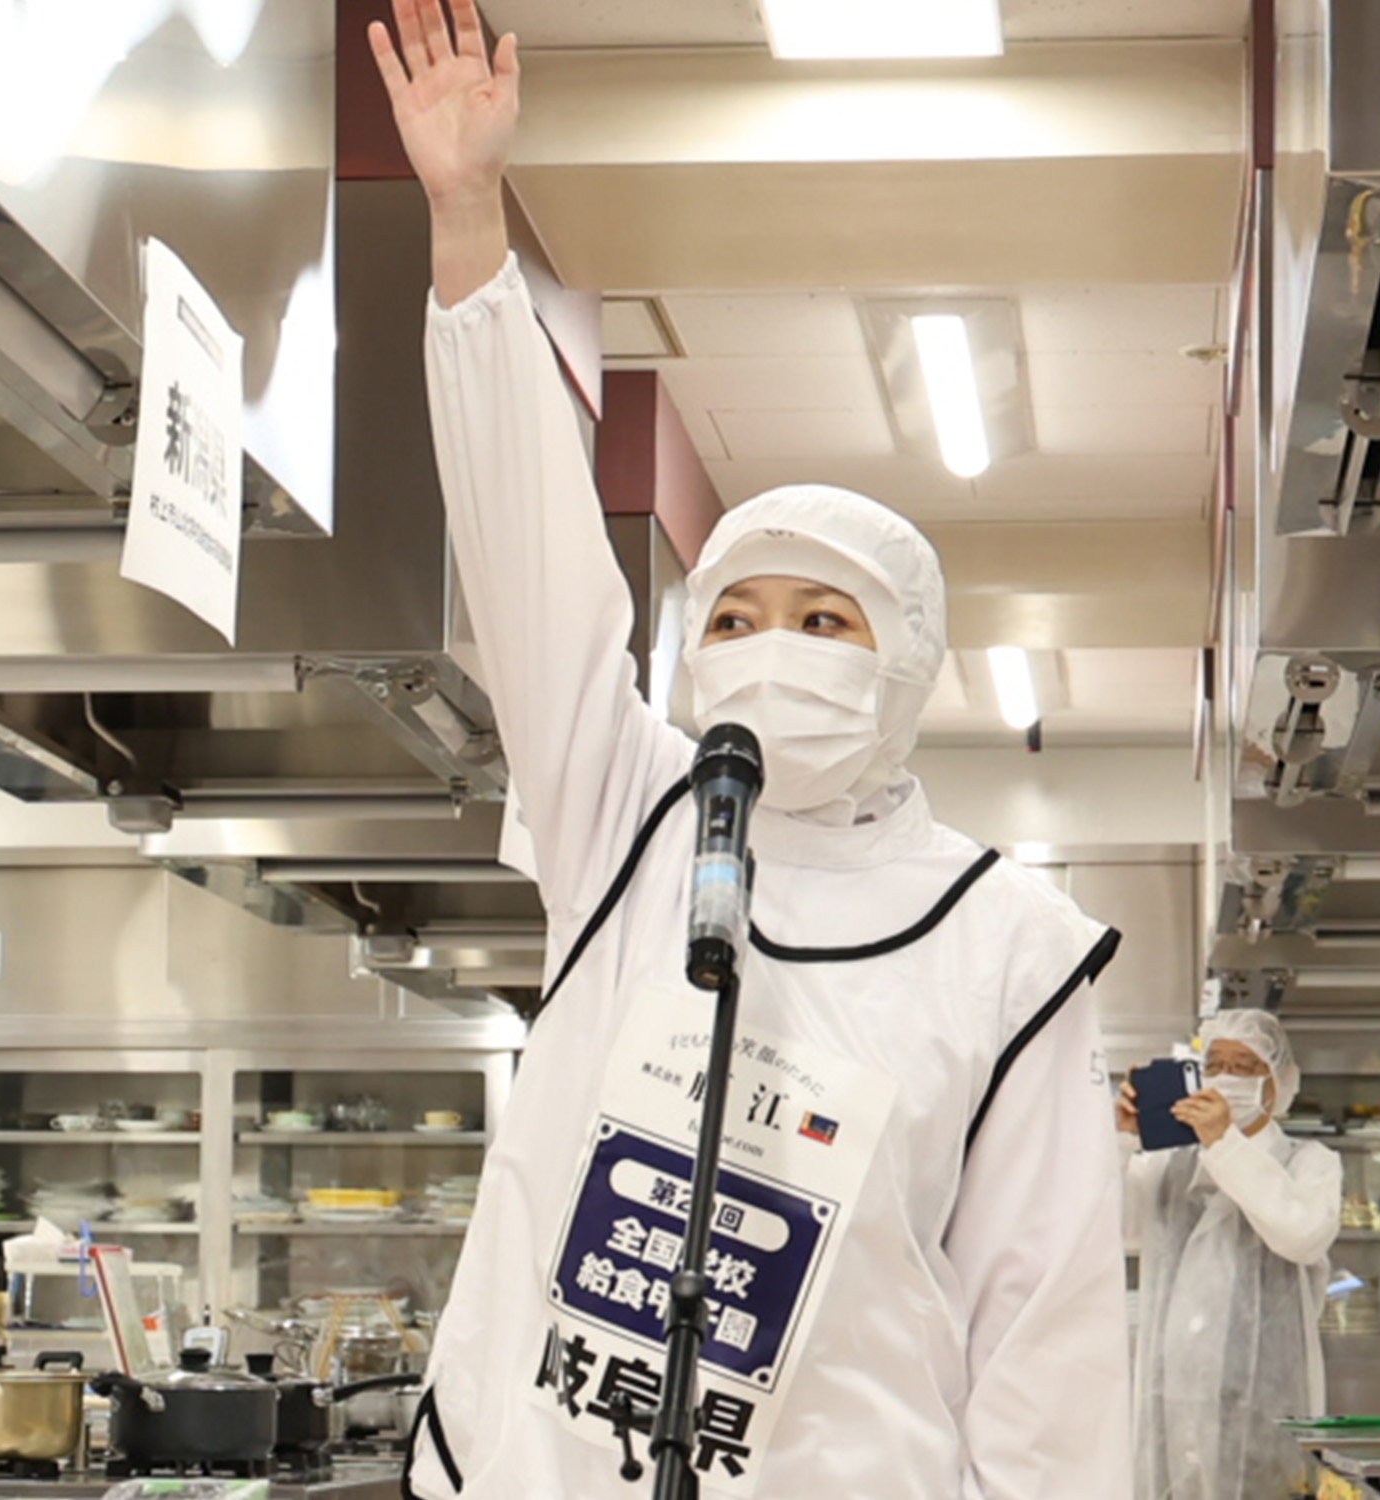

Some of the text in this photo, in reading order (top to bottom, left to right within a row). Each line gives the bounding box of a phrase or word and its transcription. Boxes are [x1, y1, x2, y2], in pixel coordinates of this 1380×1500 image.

[649, 1176, 745, 1234] 第2回
[576, 1252, 758, 1352] 給食甲園
[606, 1216, 757, 1299] 全国校
[535, 1323, 756, 1479] 岐阜県
